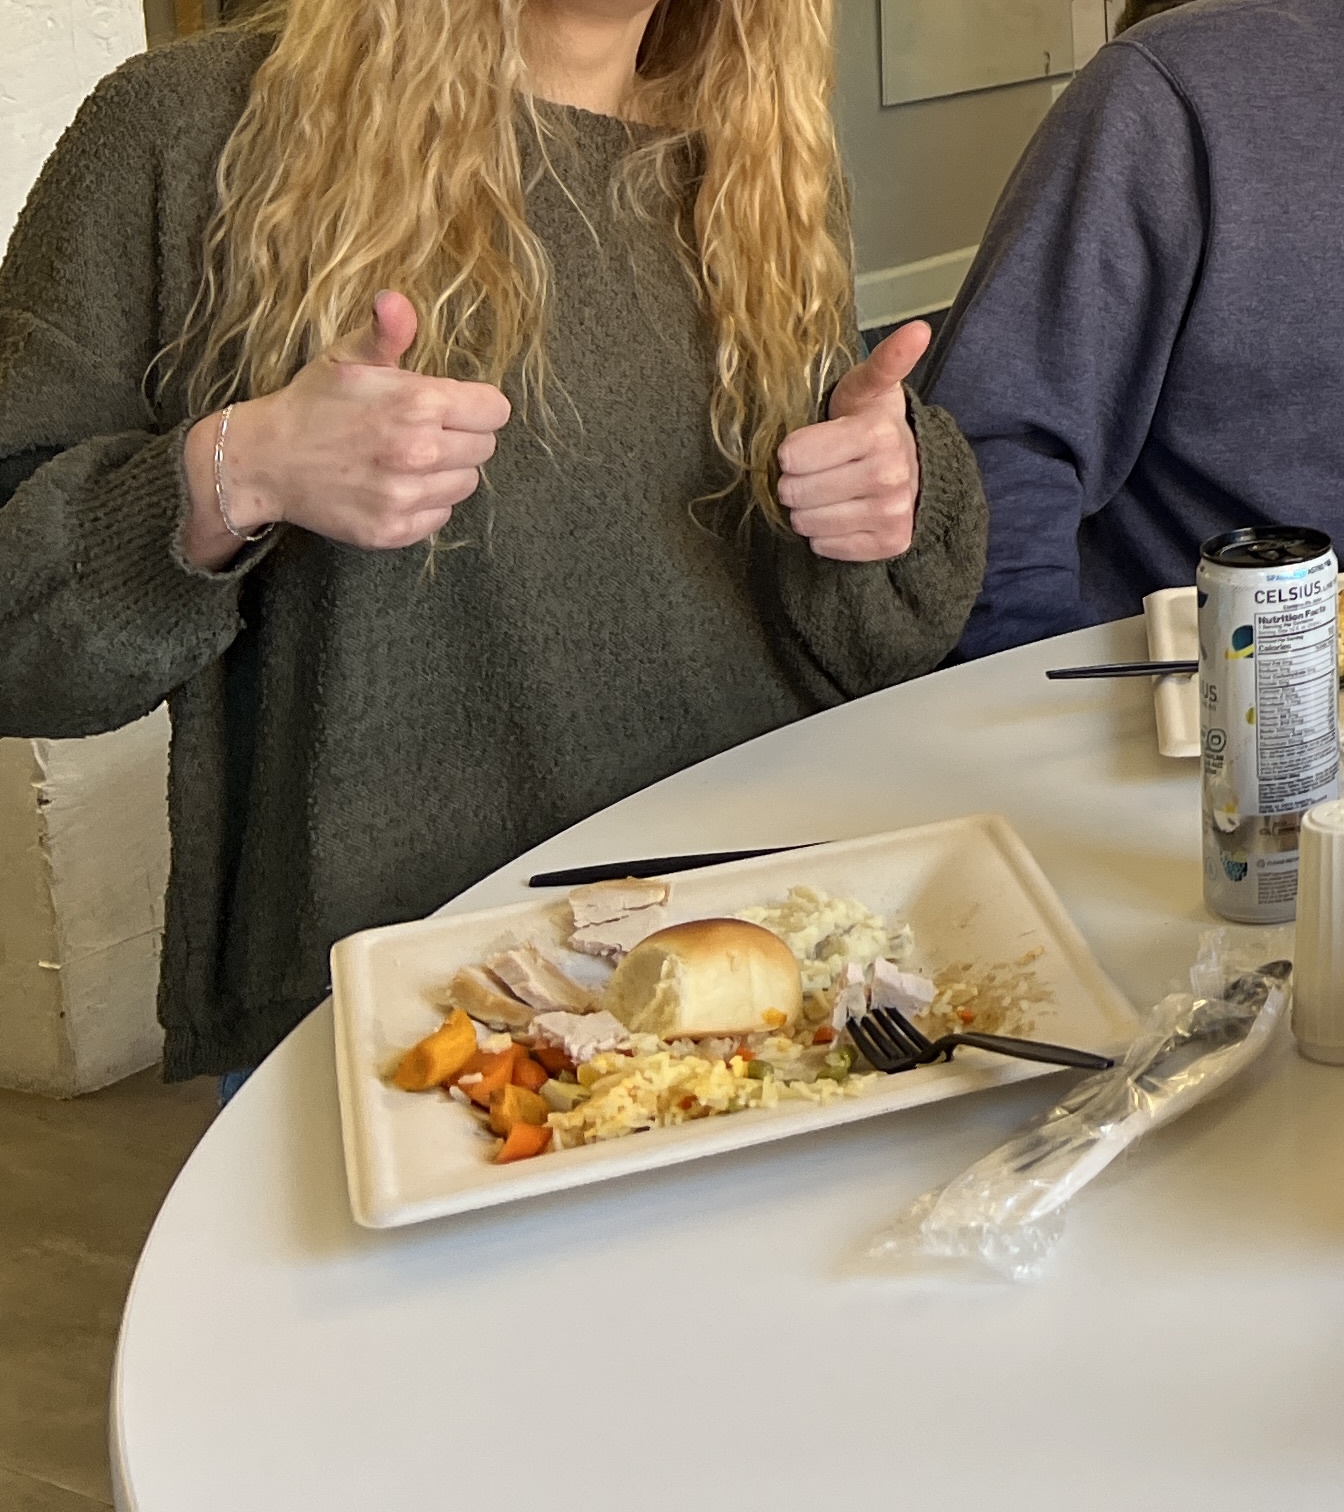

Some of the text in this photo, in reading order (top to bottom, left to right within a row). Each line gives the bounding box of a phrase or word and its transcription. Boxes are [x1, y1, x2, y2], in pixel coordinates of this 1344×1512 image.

[1254, 580, 1322, 605] CELSIUS
[1258, 605, 1327, 625] Nutrition Facts
